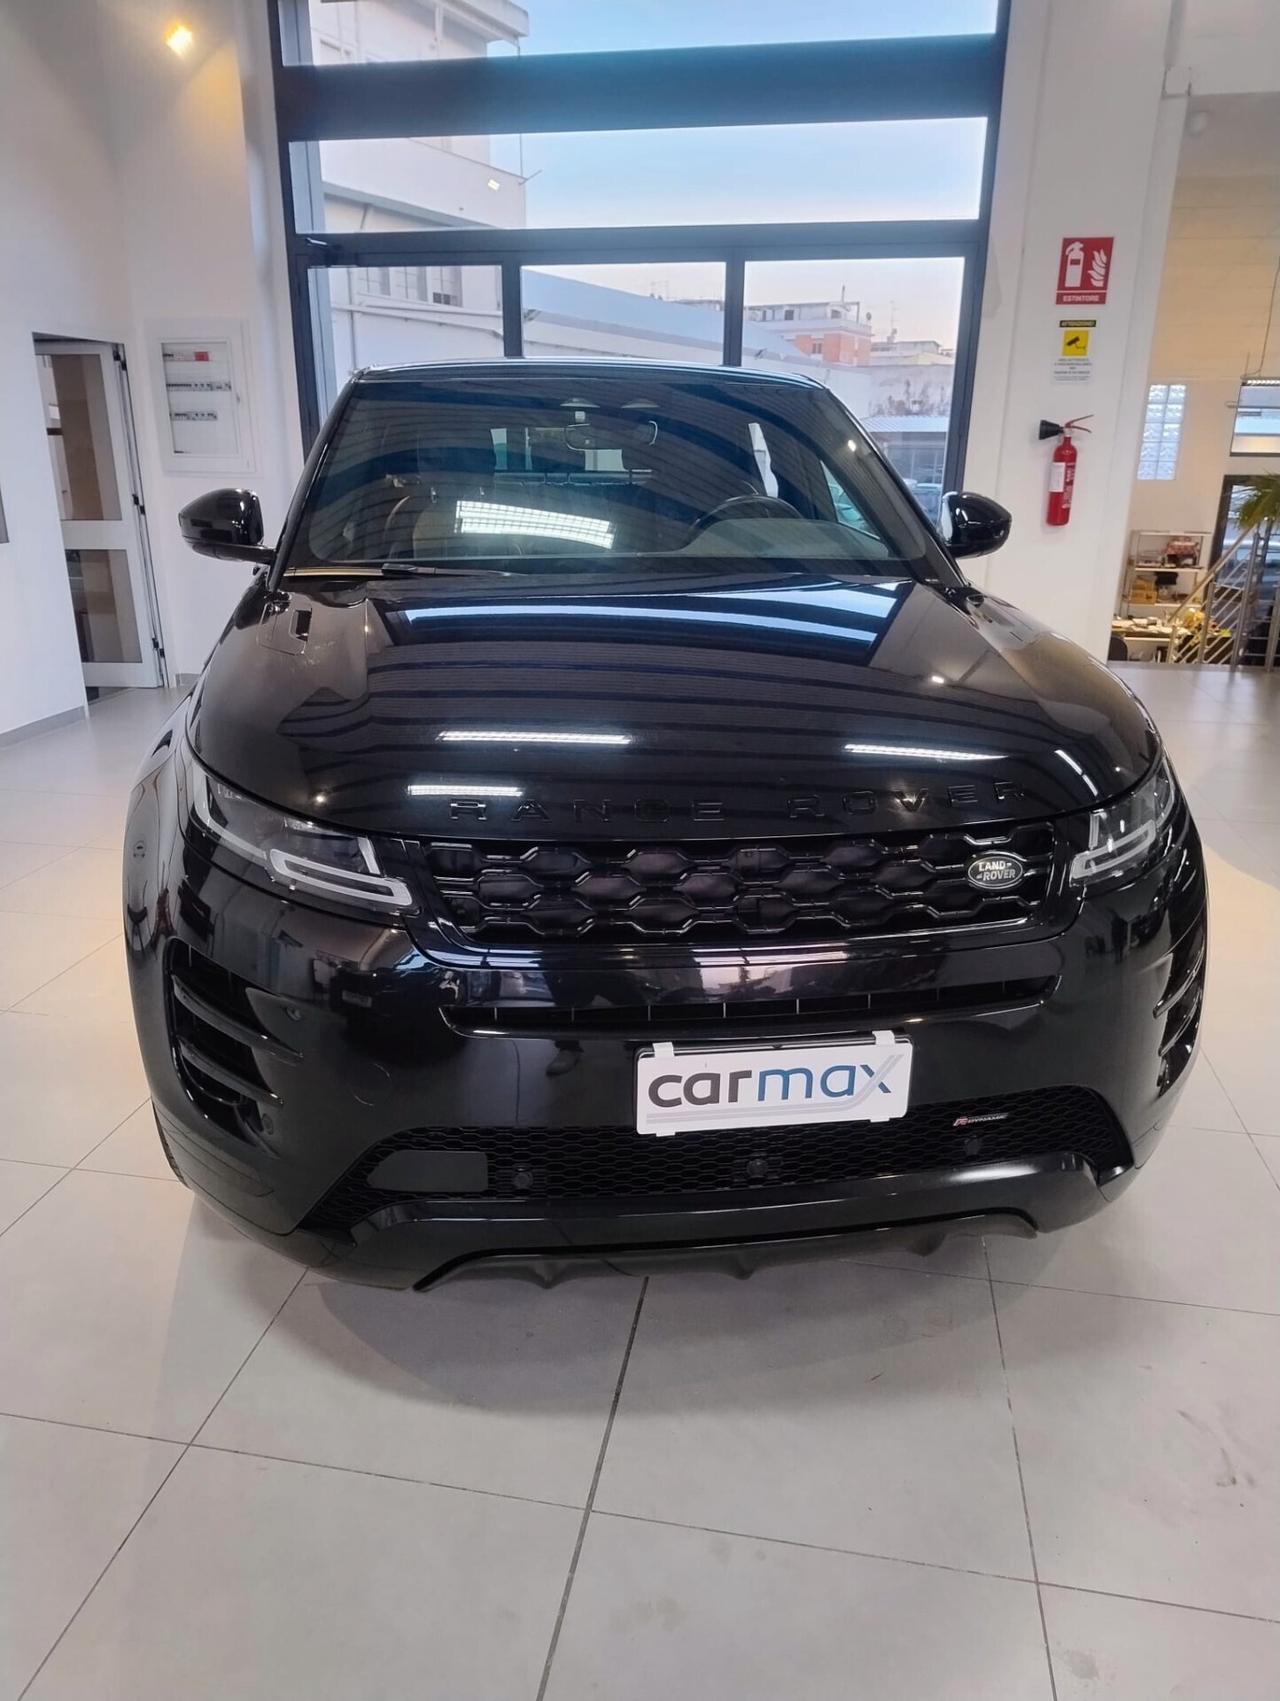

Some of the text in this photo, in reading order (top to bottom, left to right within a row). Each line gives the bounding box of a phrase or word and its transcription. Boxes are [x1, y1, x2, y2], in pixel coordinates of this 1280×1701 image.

[448, 780, 1026, 823] RANGE ROVER
[978, 860, 1006, 872] LAND
[983, 868, 1016, 881] ROVER
[648, 1061, 894, 1108] carmax
